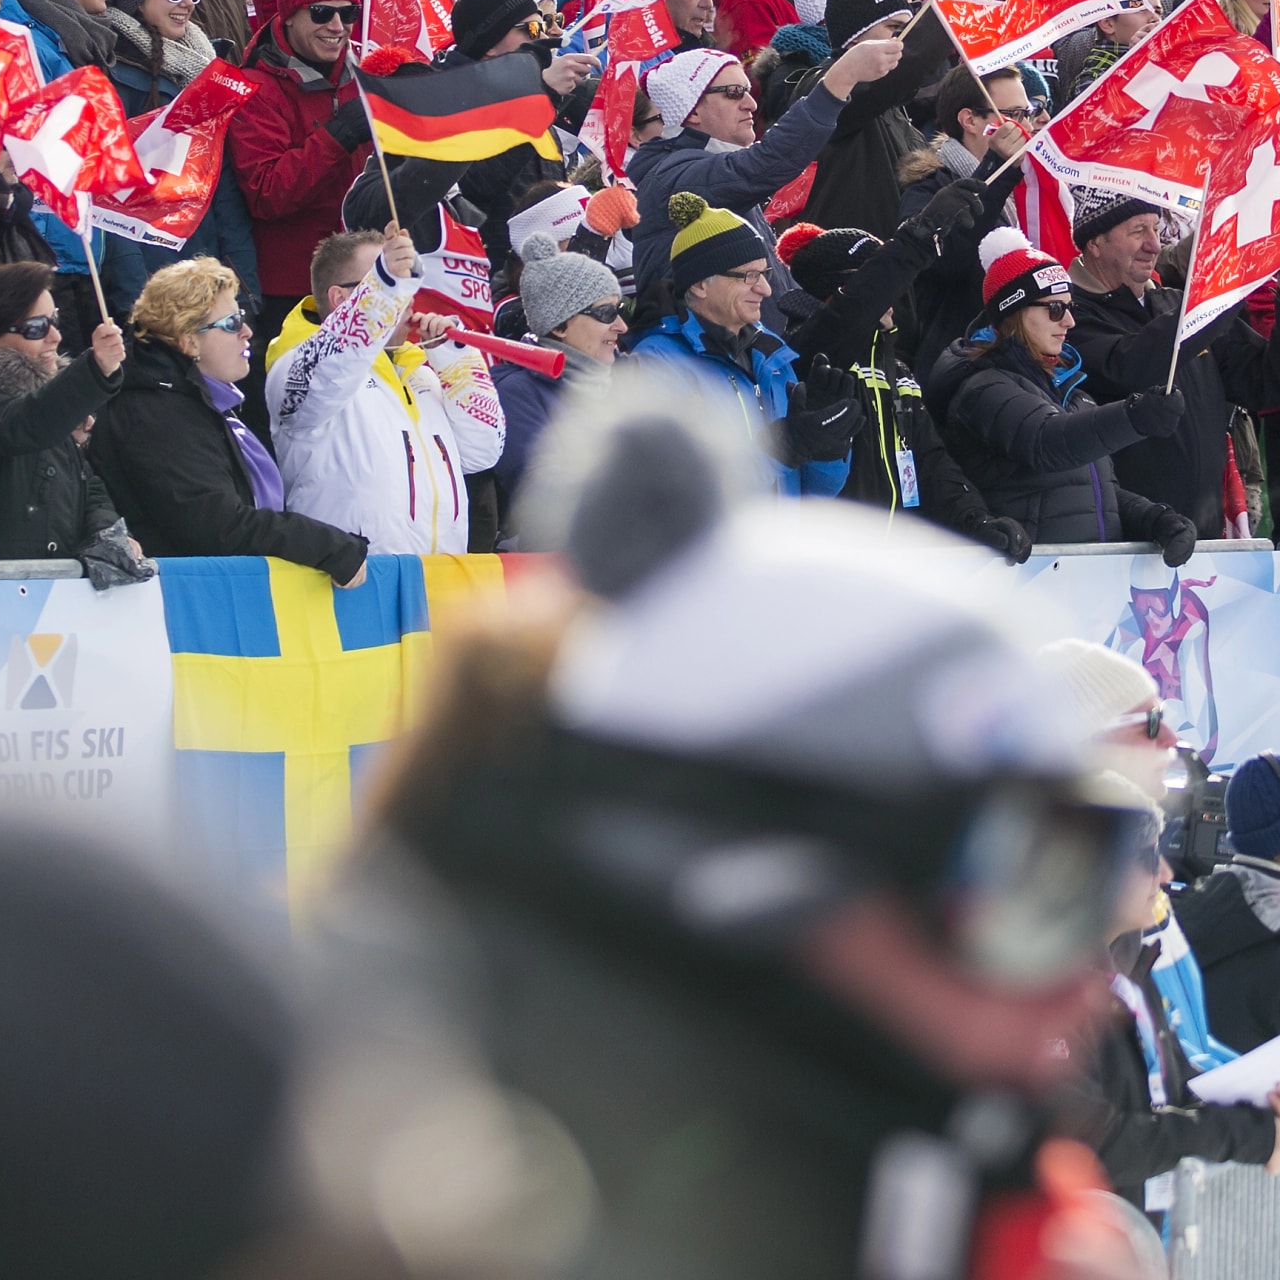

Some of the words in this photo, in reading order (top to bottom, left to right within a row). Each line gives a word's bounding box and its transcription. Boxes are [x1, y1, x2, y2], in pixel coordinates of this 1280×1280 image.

[987, 41, 1034, 69] swisscom
[1041, 17, 1076, 40] RAIFFEISEN
[1079, 6, 1107, 20] helvetia
[1040, 147, 1081, 179] swisscom
[1092, 174, 1131, 188] RAIFFEISEN
[1137, 183, 1162, 199] helvetia
[102, 217, 129, 232] helvetia
[1184, 300, 1228, 331] swisscom
[30, 729, 71, 762] FIS
[81, 726, 125, 759] SKI
[63, 768, 114, 801] CUP
